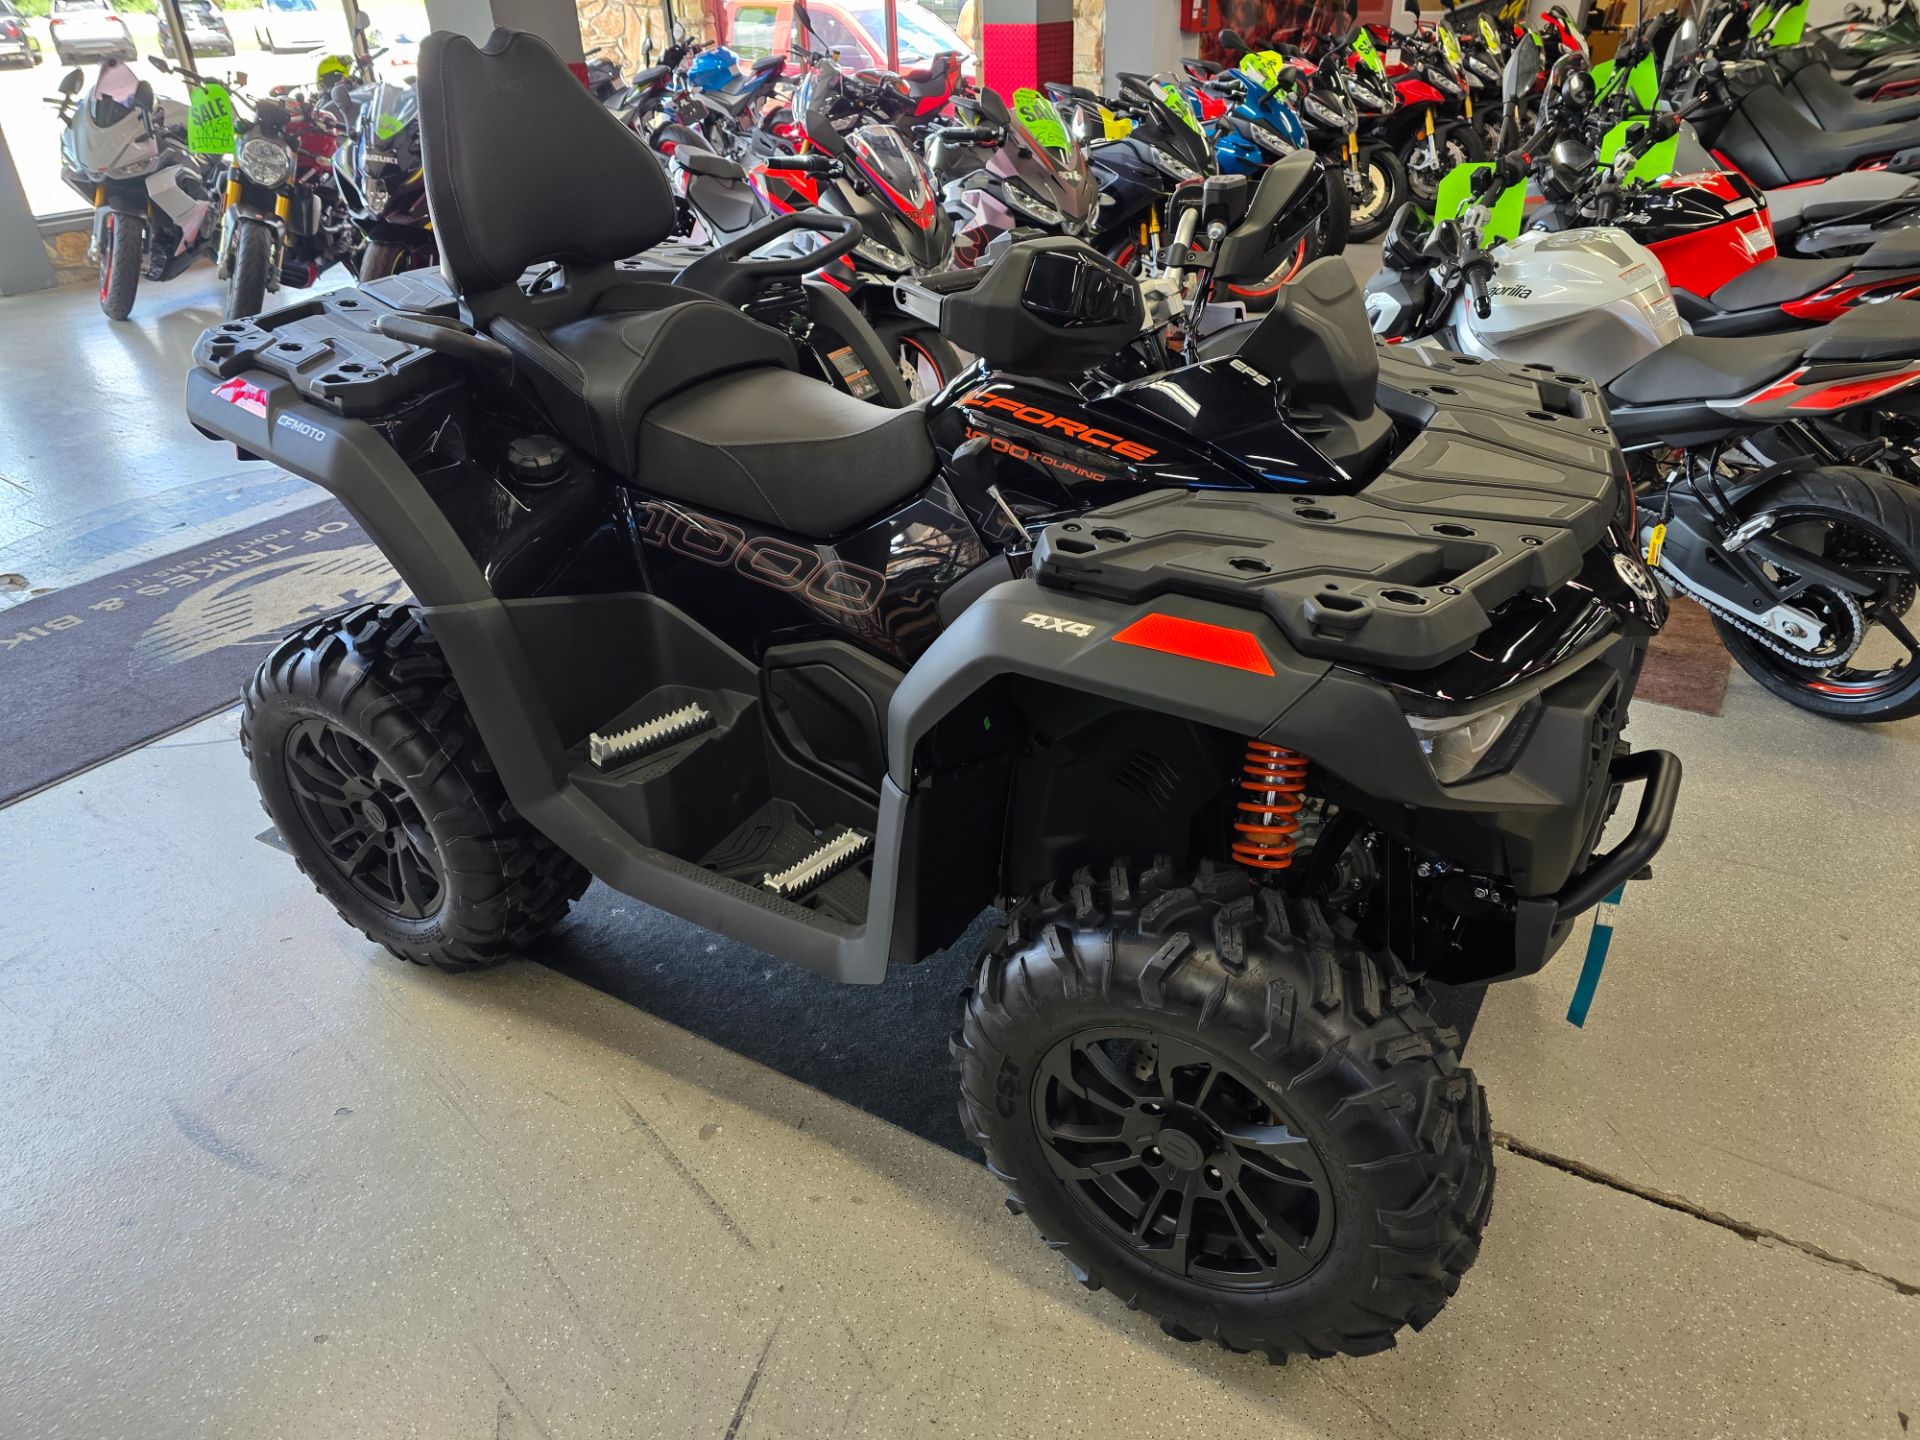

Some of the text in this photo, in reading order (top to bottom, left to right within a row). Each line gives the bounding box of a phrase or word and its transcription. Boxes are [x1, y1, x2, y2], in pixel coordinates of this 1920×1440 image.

[191, 96, 228, 126] SALE
[1488, 284, 1533, 300] aprilia
[1230, 358, 1272, 387] EPS
[276, 414, 327, 442] CFMOTO
[1031, 451, 1106, 483] TOURING
[236, 528, 292, 551] FORT
[300, 521, 350, 543] OF
[135, 543, 295, 597] TRIKES
[87, 597, 125, 611] &
[995, 1053, 1021, 1120] CST
